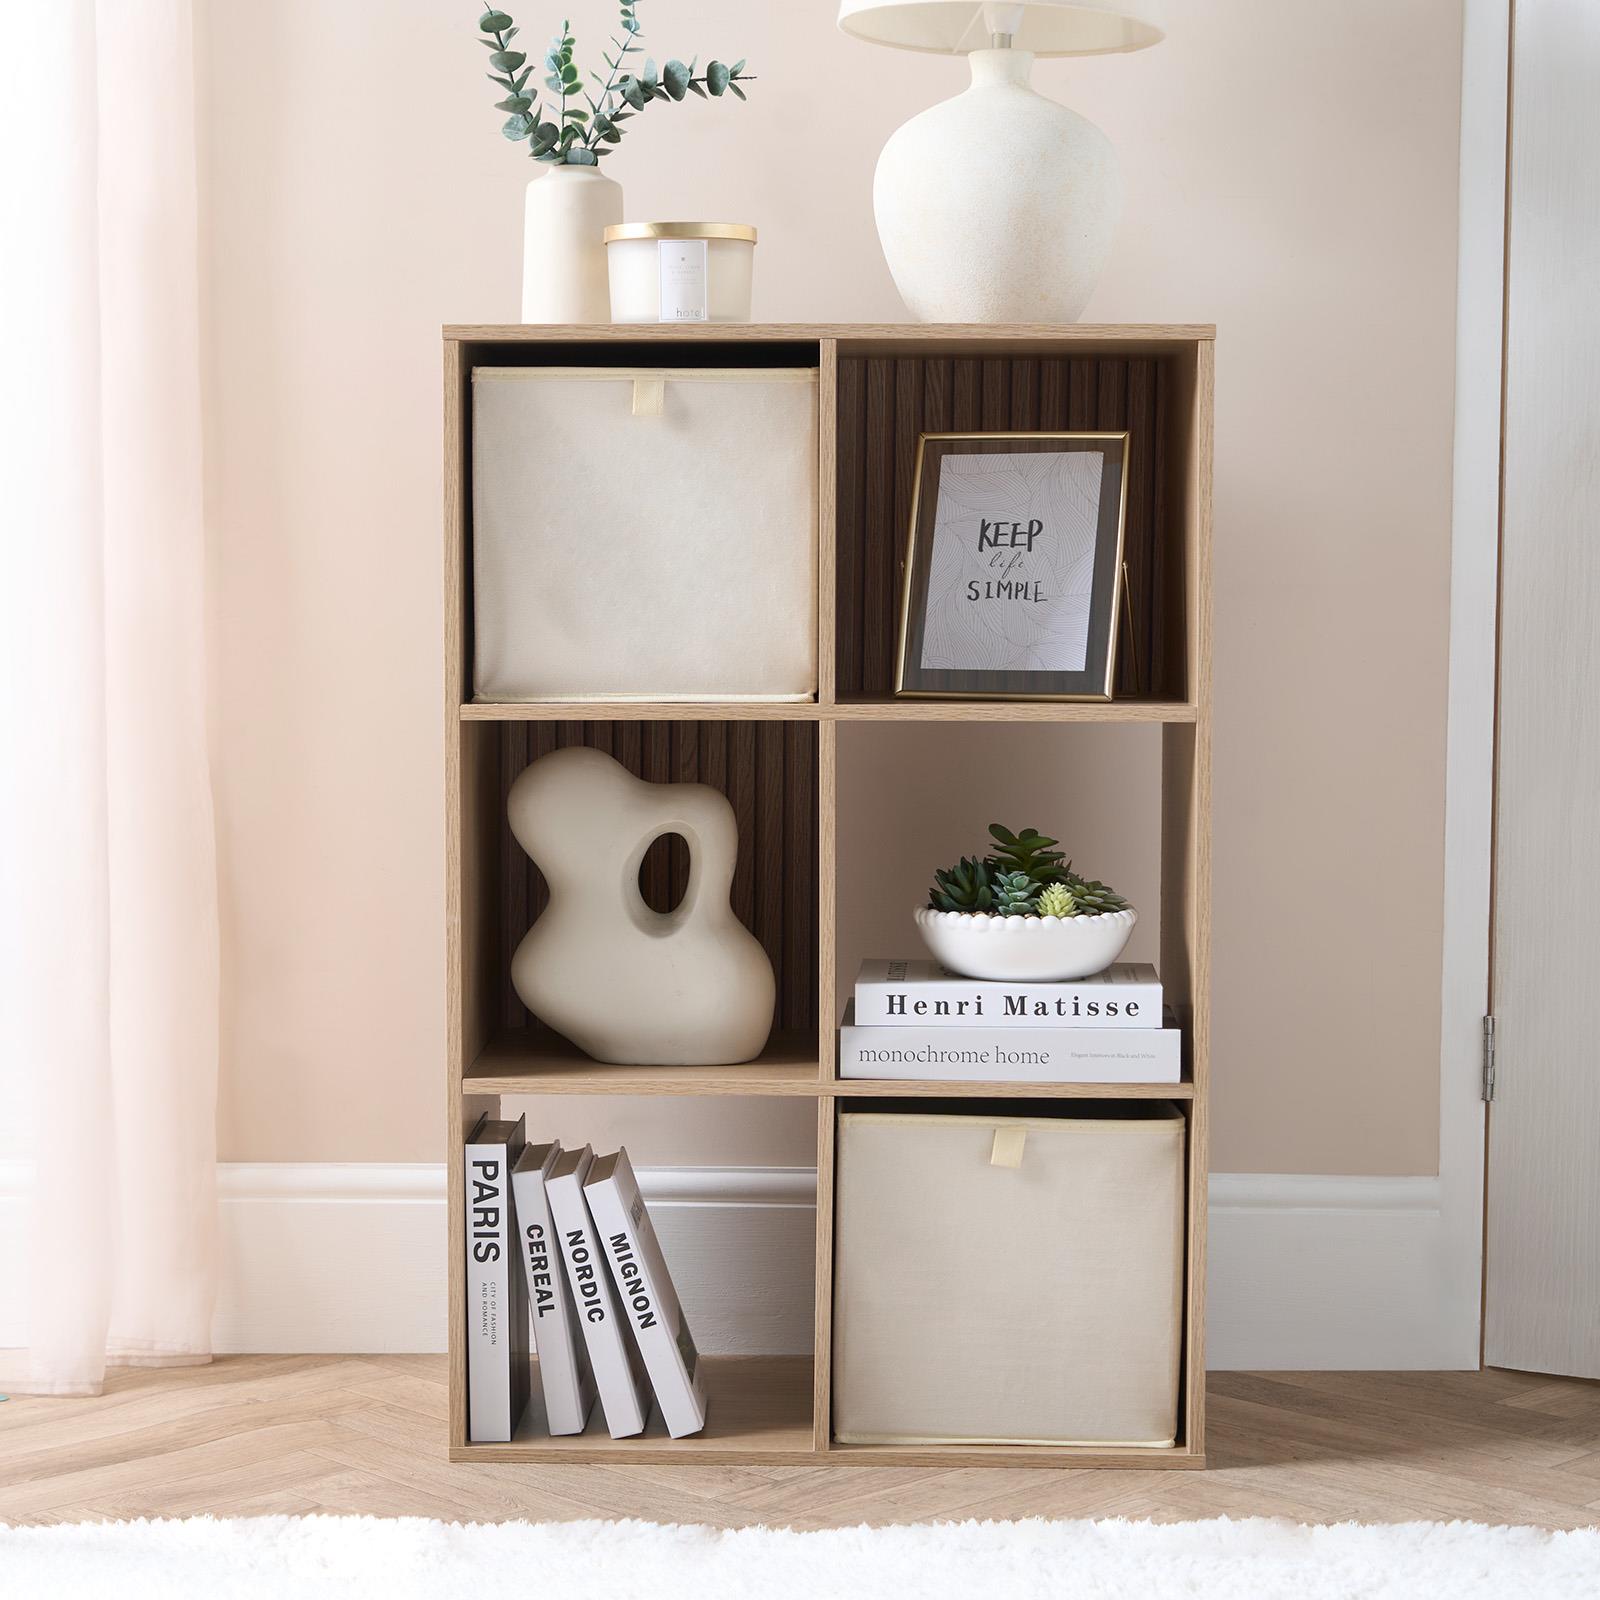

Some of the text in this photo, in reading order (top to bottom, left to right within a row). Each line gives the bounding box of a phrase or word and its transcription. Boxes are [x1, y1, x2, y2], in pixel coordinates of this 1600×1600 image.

[978, 519, 1043, 552] KEEP
[989, 551, 1024, 579] life
[967, 580, 1048, 603] SIMPLE
[886, 994, 1139, 1016] Henri Matisse
[860, 1045, 1049, 1064] monochrome home
[472, 1160, 500, 1263] PARIS
[526, 1224, 555, 1318] CEREAL
[566, 1229, 605, 1323] NORDIC
[609, 1232, 657, 1330] MIGNON
[490, 1301, 496, 1310] OF
